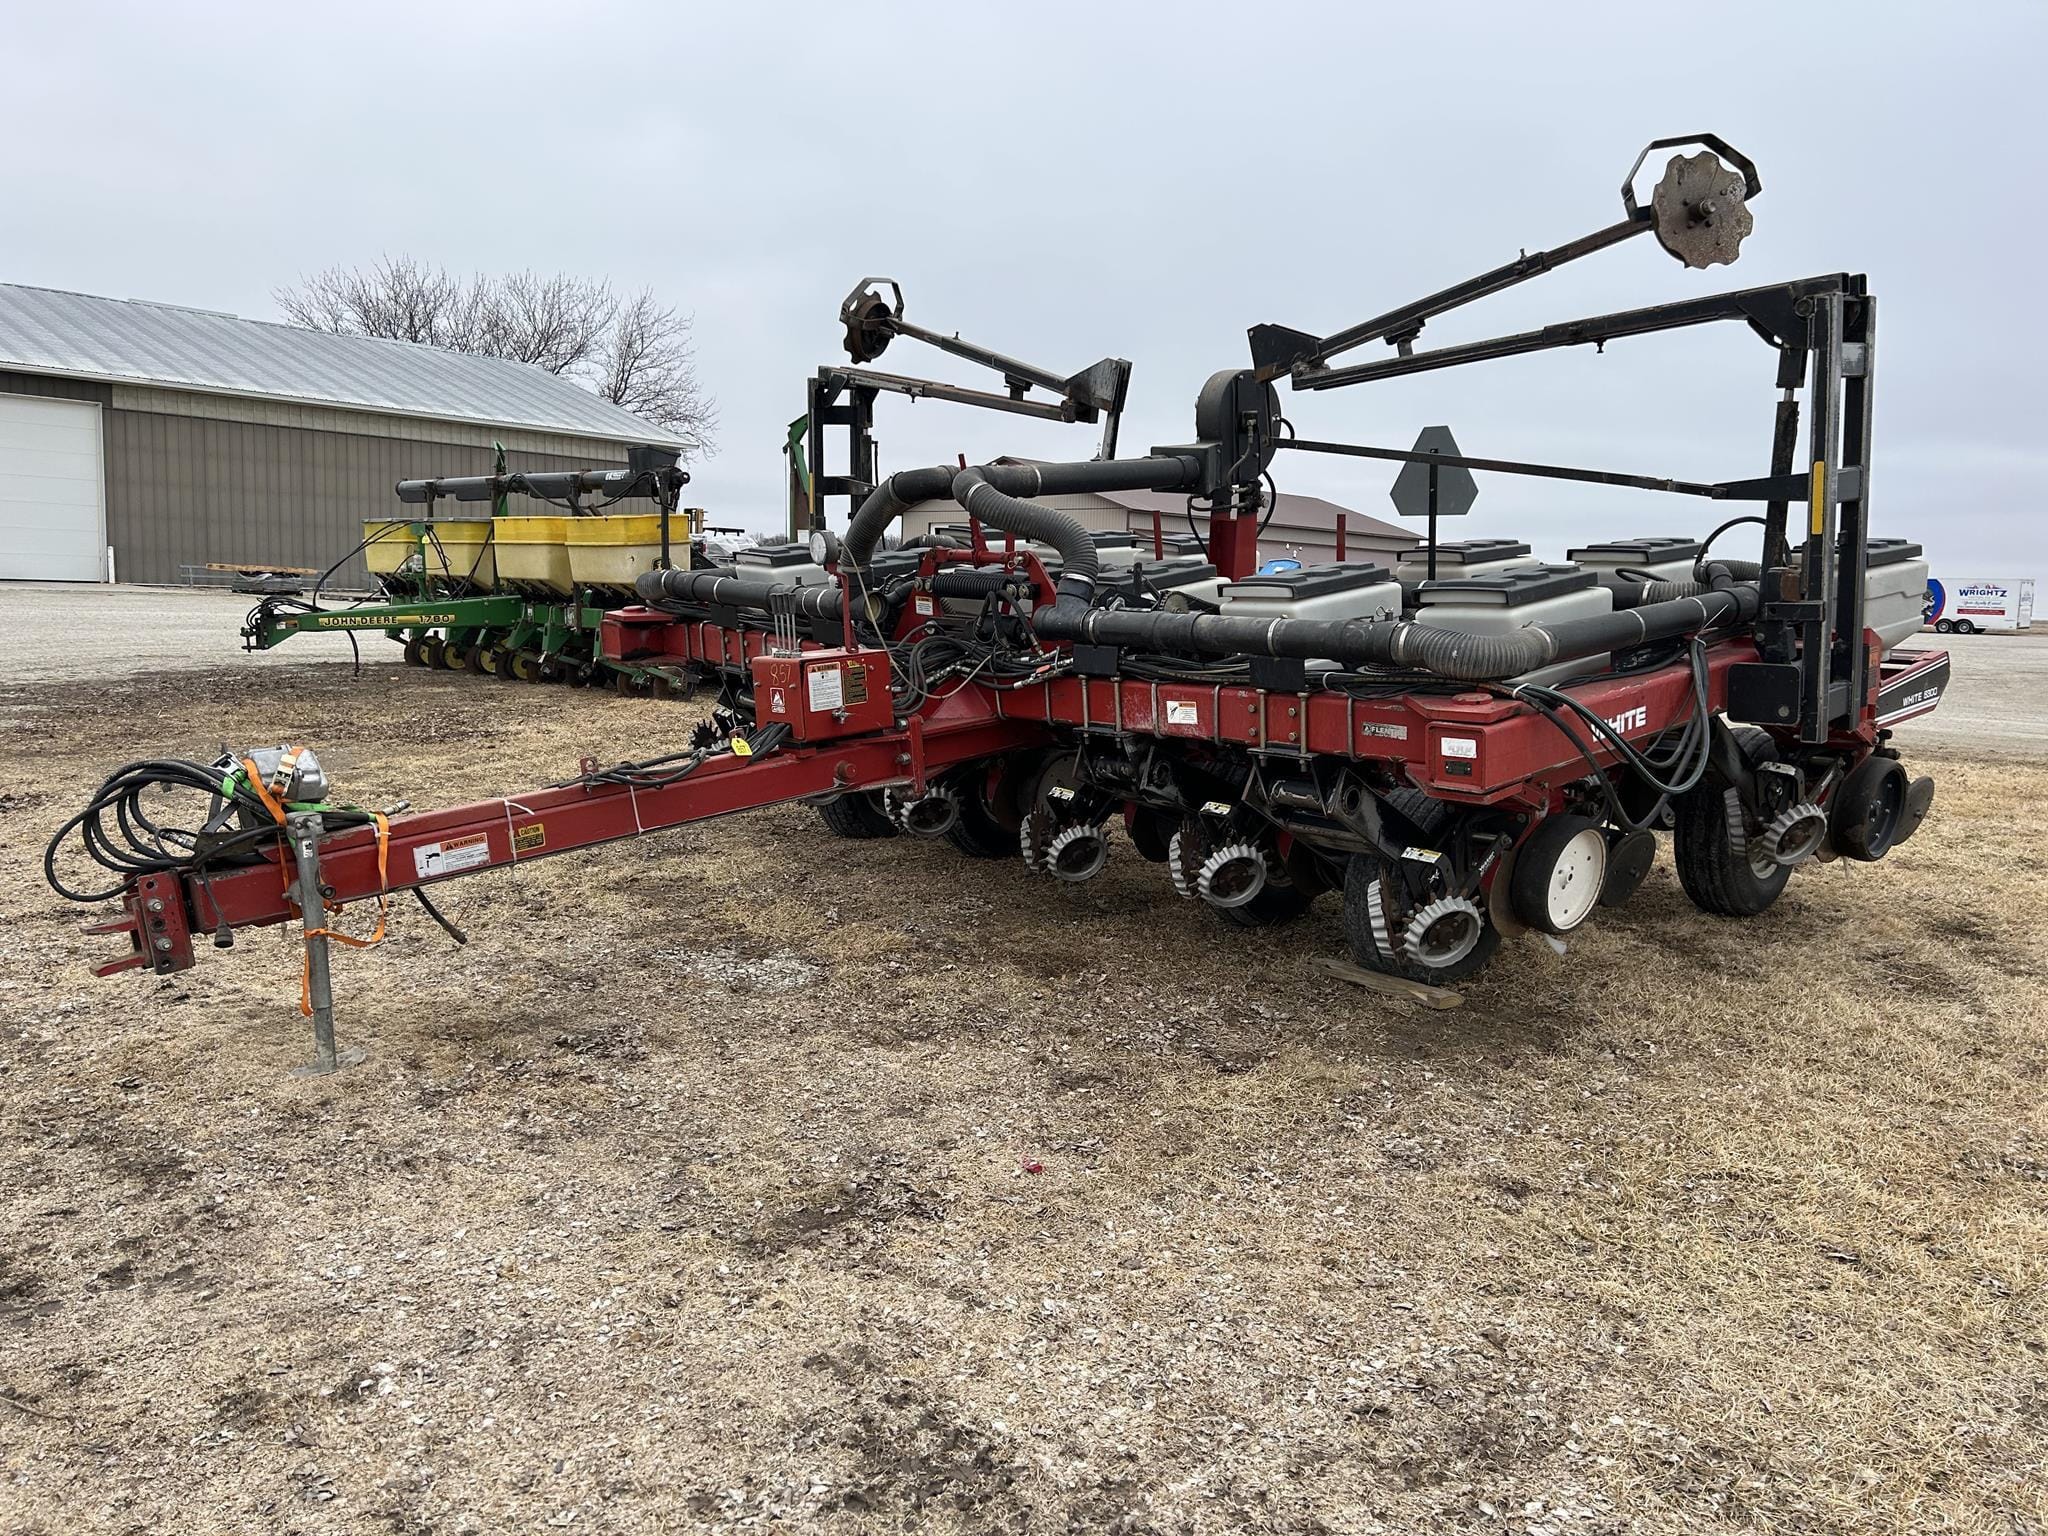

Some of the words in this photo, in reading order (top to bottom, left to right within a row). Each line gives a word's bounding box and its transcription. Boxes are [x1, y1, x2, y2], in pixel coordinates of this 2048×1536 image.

[1958, 588, 2008, 598] WRIGHTZ
[324, 617, 357, 626] JOHN
[360, 616, 398, 625] DEERE
[418, 615, 450, 624] 1780
[770, 663, 792, 686] 857
[1902, 691, 1923, 707] WHITE
[520, 827, 540, 836] CAUTION
[453, 836, 485, 848] WARNING
